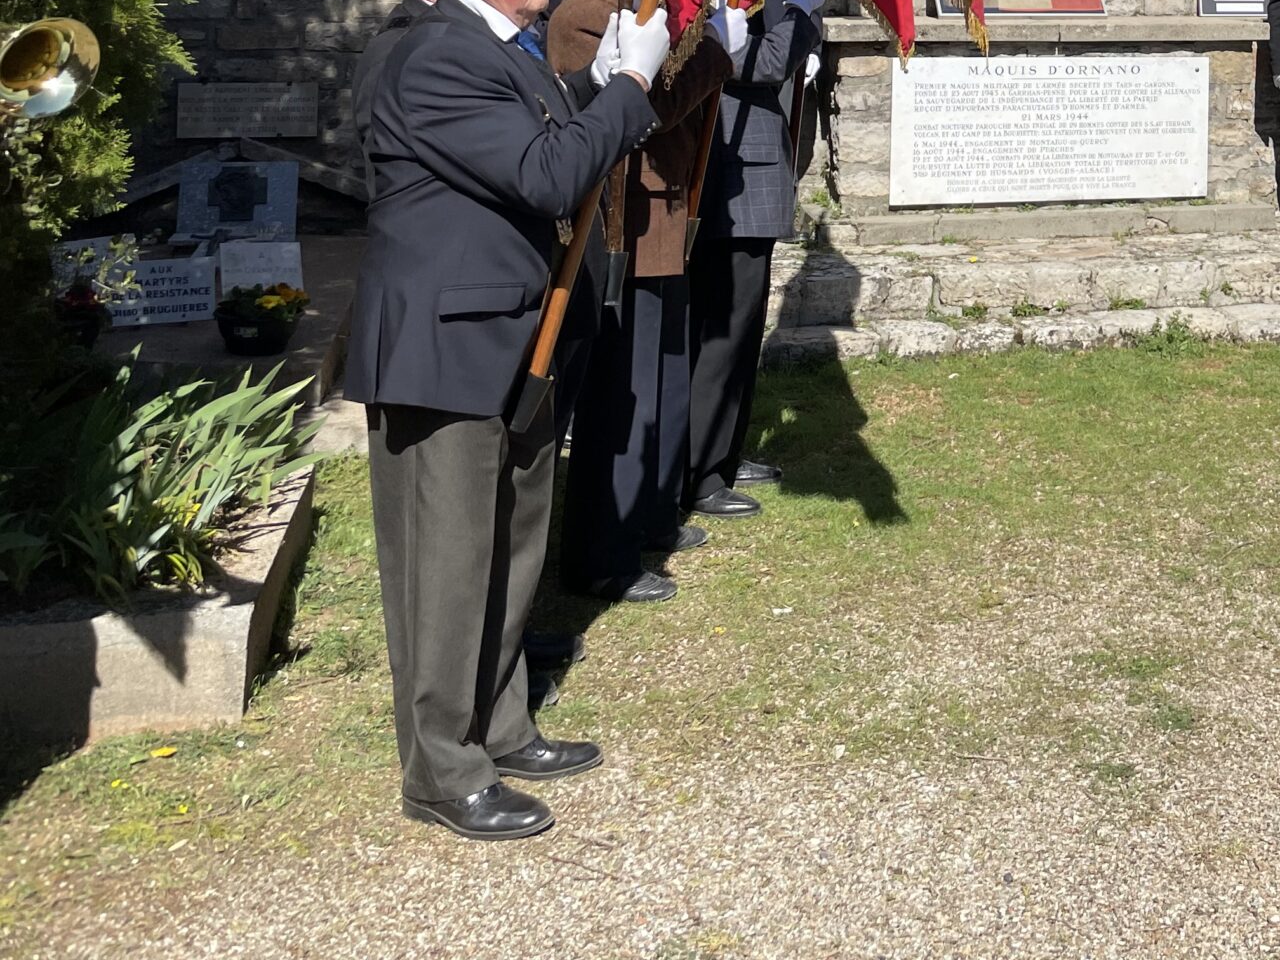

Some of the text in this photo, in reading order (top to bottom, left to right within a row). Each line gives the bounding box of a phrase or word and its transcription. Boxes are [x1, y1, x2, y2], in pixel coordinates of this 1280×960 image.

[968, 65, 1141, 76] MAQUIS D'ORNANO
[1036, 113, 1061, 121] MARS
[990, 169, 1035, 177] HUSSARDS
[150, 266, 173, 274] AUX
[133, 277, 189, 287] MARTYRS
[128, 291, 142, 300] LA
